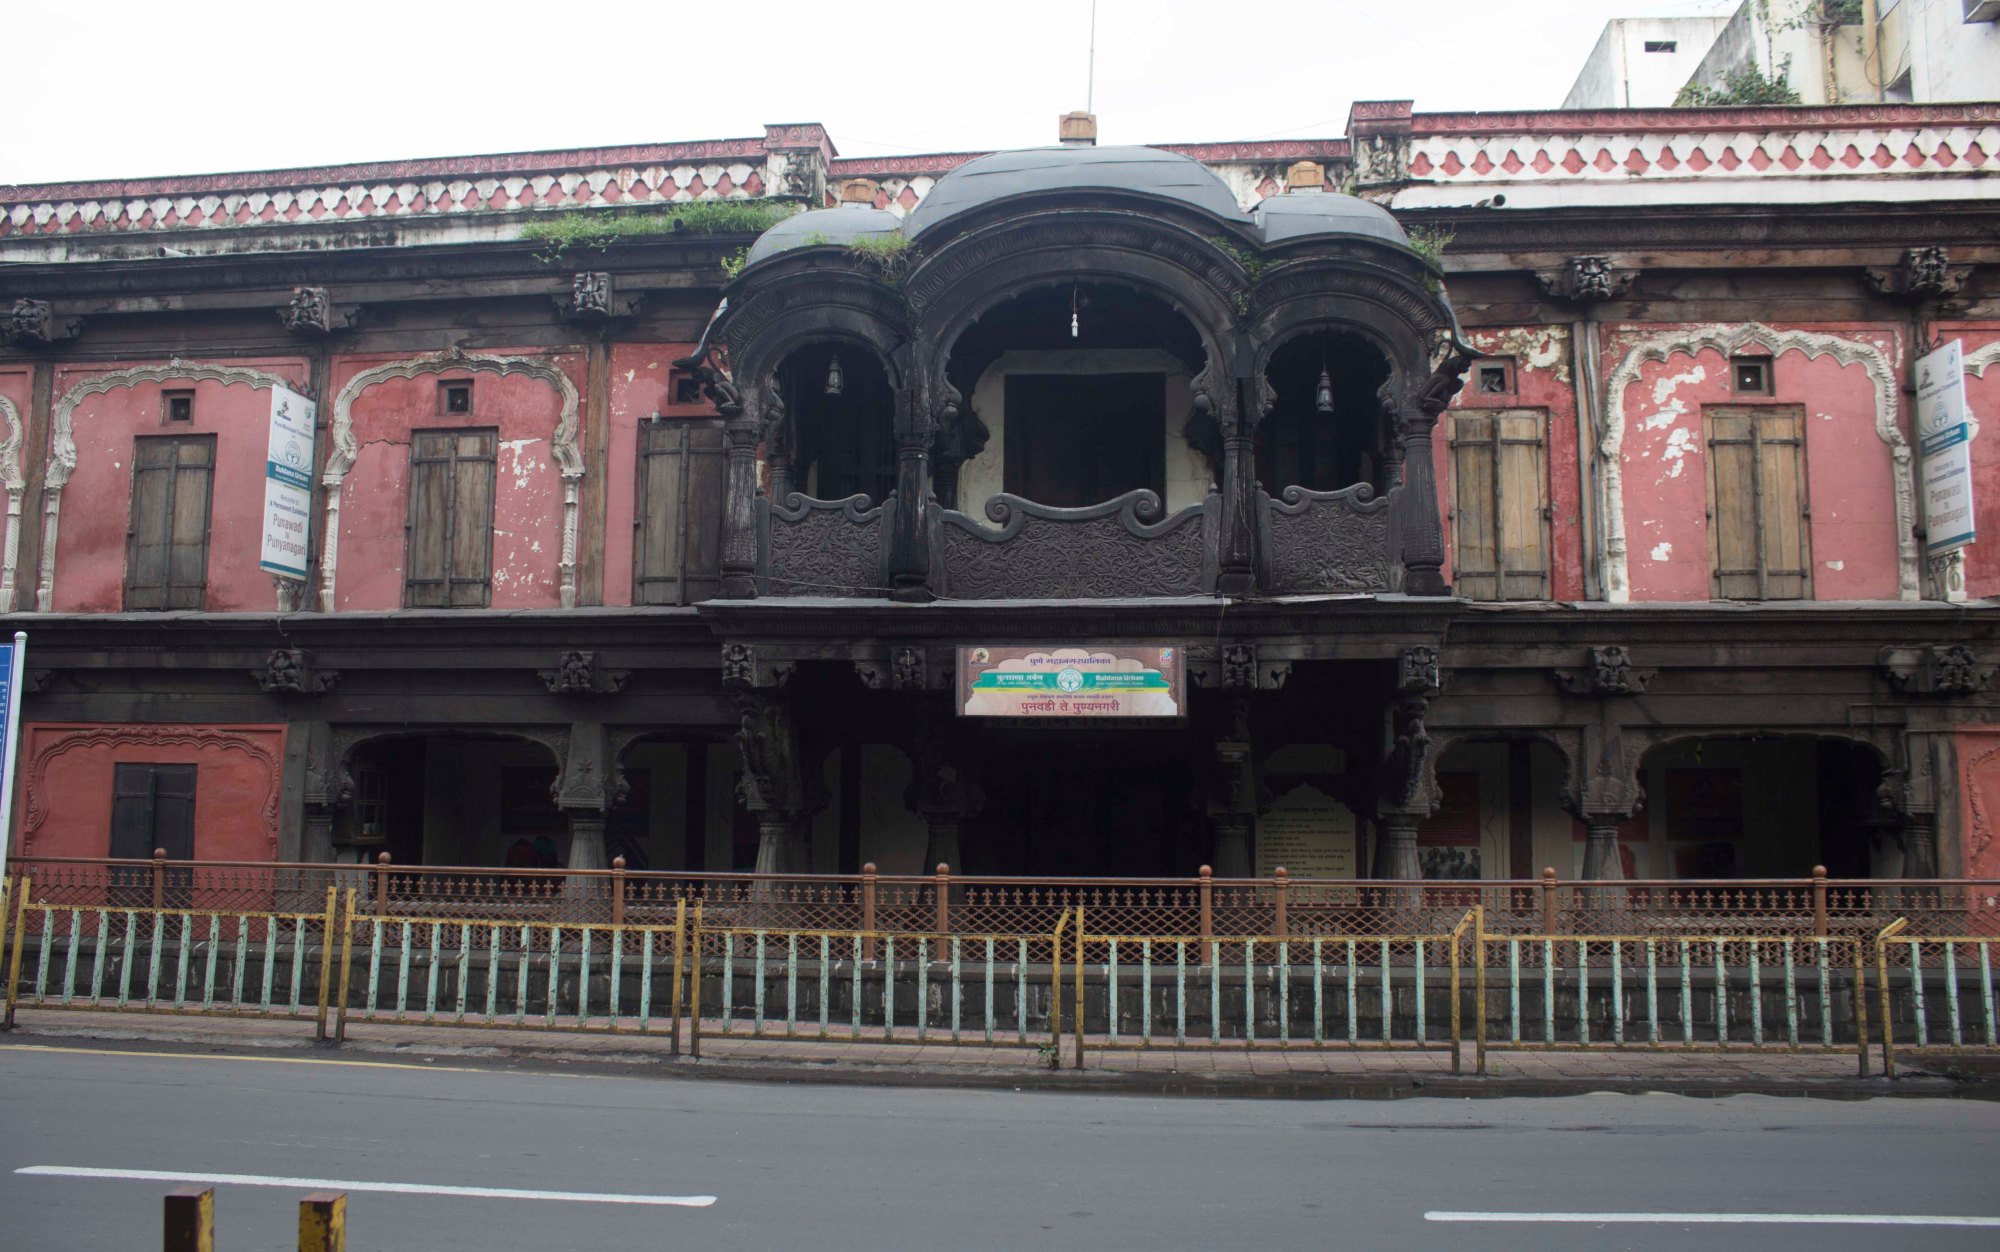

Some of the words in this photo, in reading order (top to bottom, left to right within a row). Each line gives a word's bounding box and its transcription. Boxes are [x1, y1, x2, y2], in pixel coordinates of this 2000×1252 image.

[275, 464, 295, 478] Buldana
[294, 471, 309, 483] Urban
[1930, 482, 1961, 503] Punawadi
[273, 500, 292, 512] Permanent
[273, 514, 303, 534] Punawadi
[1928, 506, 1968, 527] Punyanagari
[267, 535, 305, 556] Punyanagari
[1030, 656, 1043, 666] पुणे
[1046, 656, 1111, 665] महानगरपालिका
[1021, 700, 1055, 714] पुनवडी
[1060, 700, 1068, 711] ते
[1073, 700, 1120, 714] पुण्यनगरी
